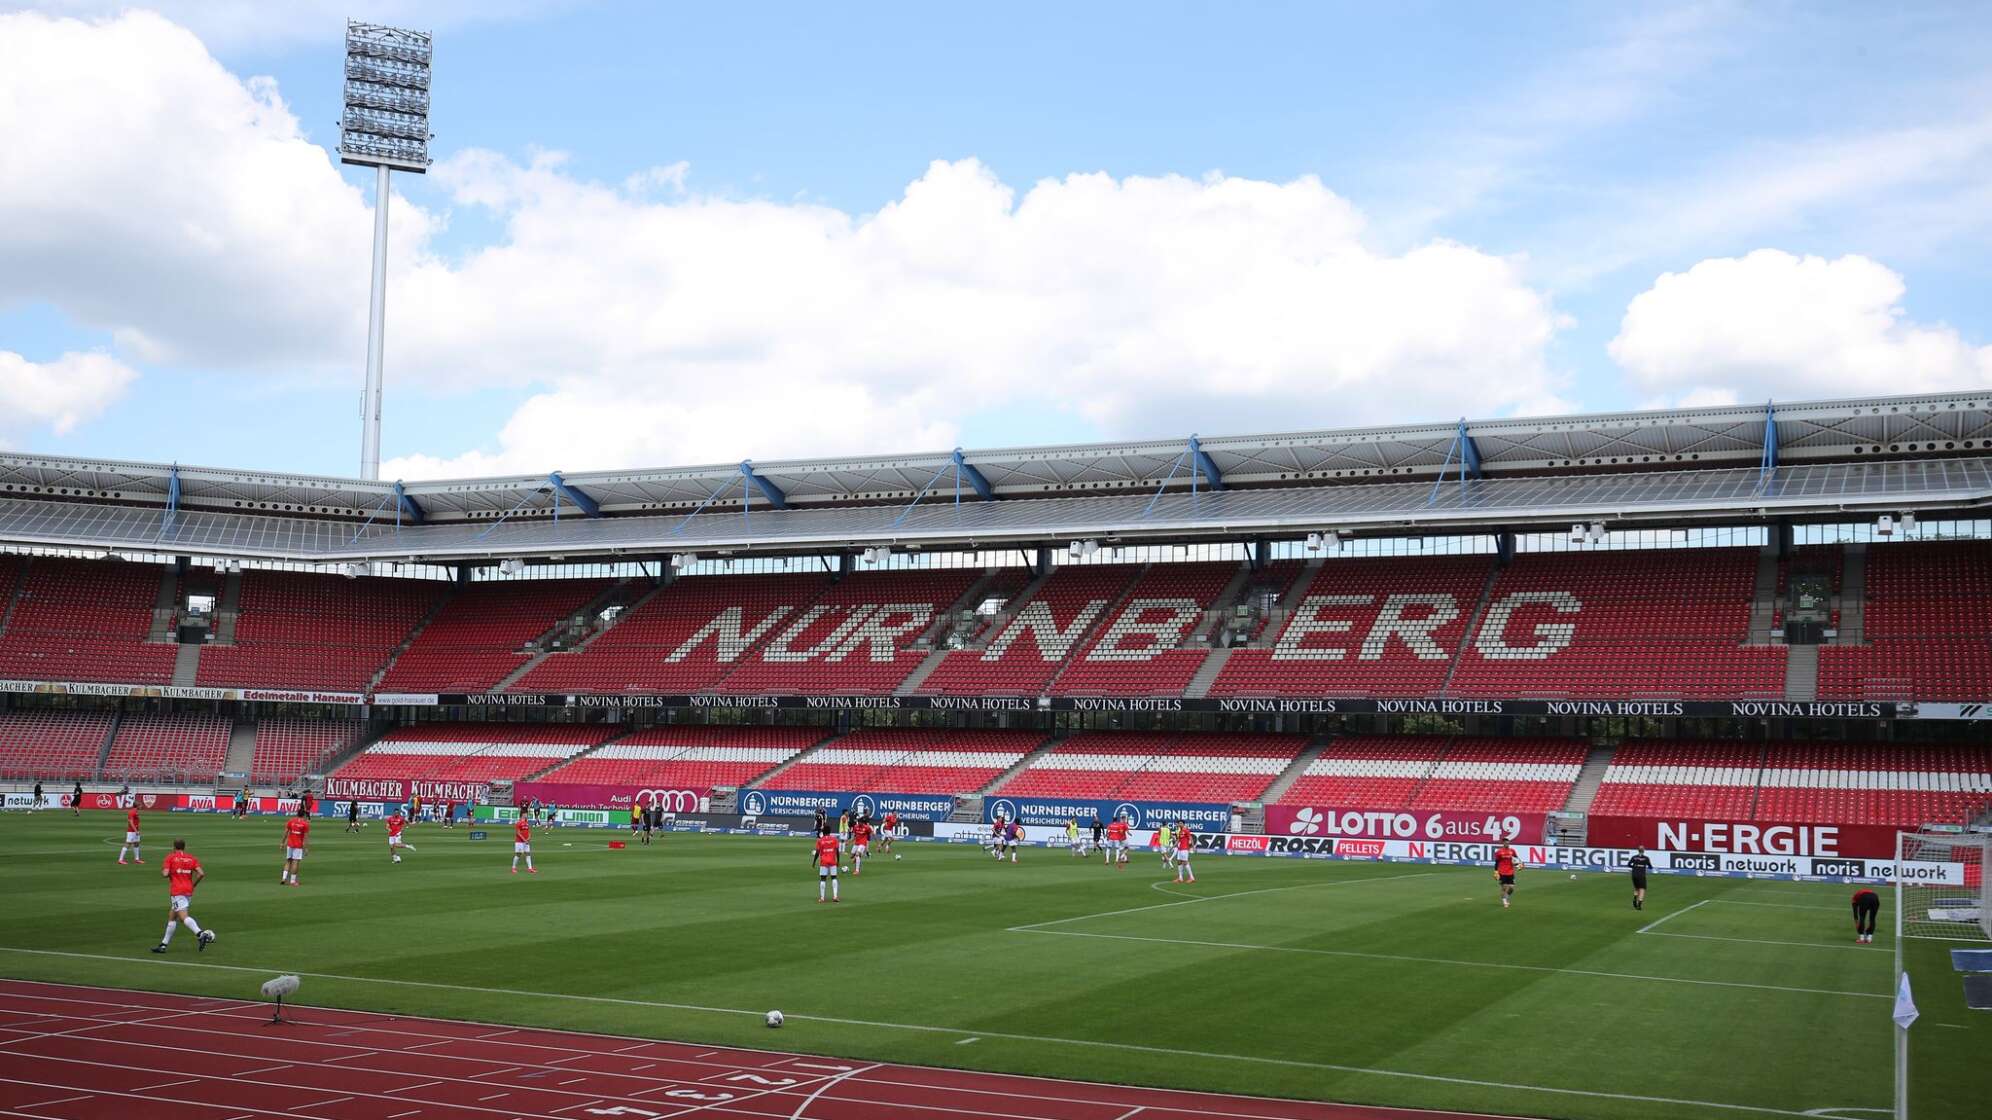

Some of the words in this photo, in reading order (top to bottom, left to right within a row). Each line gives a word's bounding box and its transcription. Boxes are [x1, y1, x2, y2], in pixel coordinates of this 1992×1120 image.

[69, 684, 129, 696] KULMBACHER
[162, 687, 223, 699] KULMBACHER
[243, 690, 311, 701] Edelmetalle
[312, 693, 361, 704] Hanauer
[467, 695, 505, 705] NOVINA
[507, 695, 546, 705] HOTELS
[580, 696, 620, 706] NOVINA
[622, 697, 663, 707] HOTELS
[689, 697, 733, 707] NOVINA
[735, 697, 778, 708] HOTELS
[806, 697, 852, 708] NOVINA
[855, 698, 901, 709] HOTELS
[930, 698, 978, 709] NOVINA
[982, 698, 1030, 710] HOTELS
[1074, 699, 1125, 710] NOVINA
[1129, 699, 1182, 711] HOTELS
[1220, 700, 1276, 712] NOVINA
[1280, 700, 1336, 712] HOTELS
[1377, 700, 1437, 712] NOVINA
[1442, 701, 1503, 713] HOTELS
[1547, 702, 1613, 715] NOVINA
[1617, 702, 1683, 715] HOTELS
[1732, 702, 1801, 716] NOVINA
[1809, 703, 1881, 717] HOTELS
[326, 778, 403, 797] KULMBACHER
[610, 794, 632, 803] Audi
[770, 795, 838, 808] NÜRNBERGER
[880, 799, 951, 812] NÜRNBERGER
[1021, 804, 1098, 817] NÜRNBERGER
[1021, 817, 1072, 825] VERSICHERUN
[1146, 808, 1227, 821] NÜRNBERGER
[1328, 810, 1417, 837] LOTTO
[1232, 836, 1263, 849] HEIZÖL
[1269, 837, 1335, 854] ROSA
[1339, 842, 1380, 855] PELLETS
[1675, 856, 1715, 870] noris
[1726, 858, 1796, 873] network
[1816, 861, 1860, 877] noris
